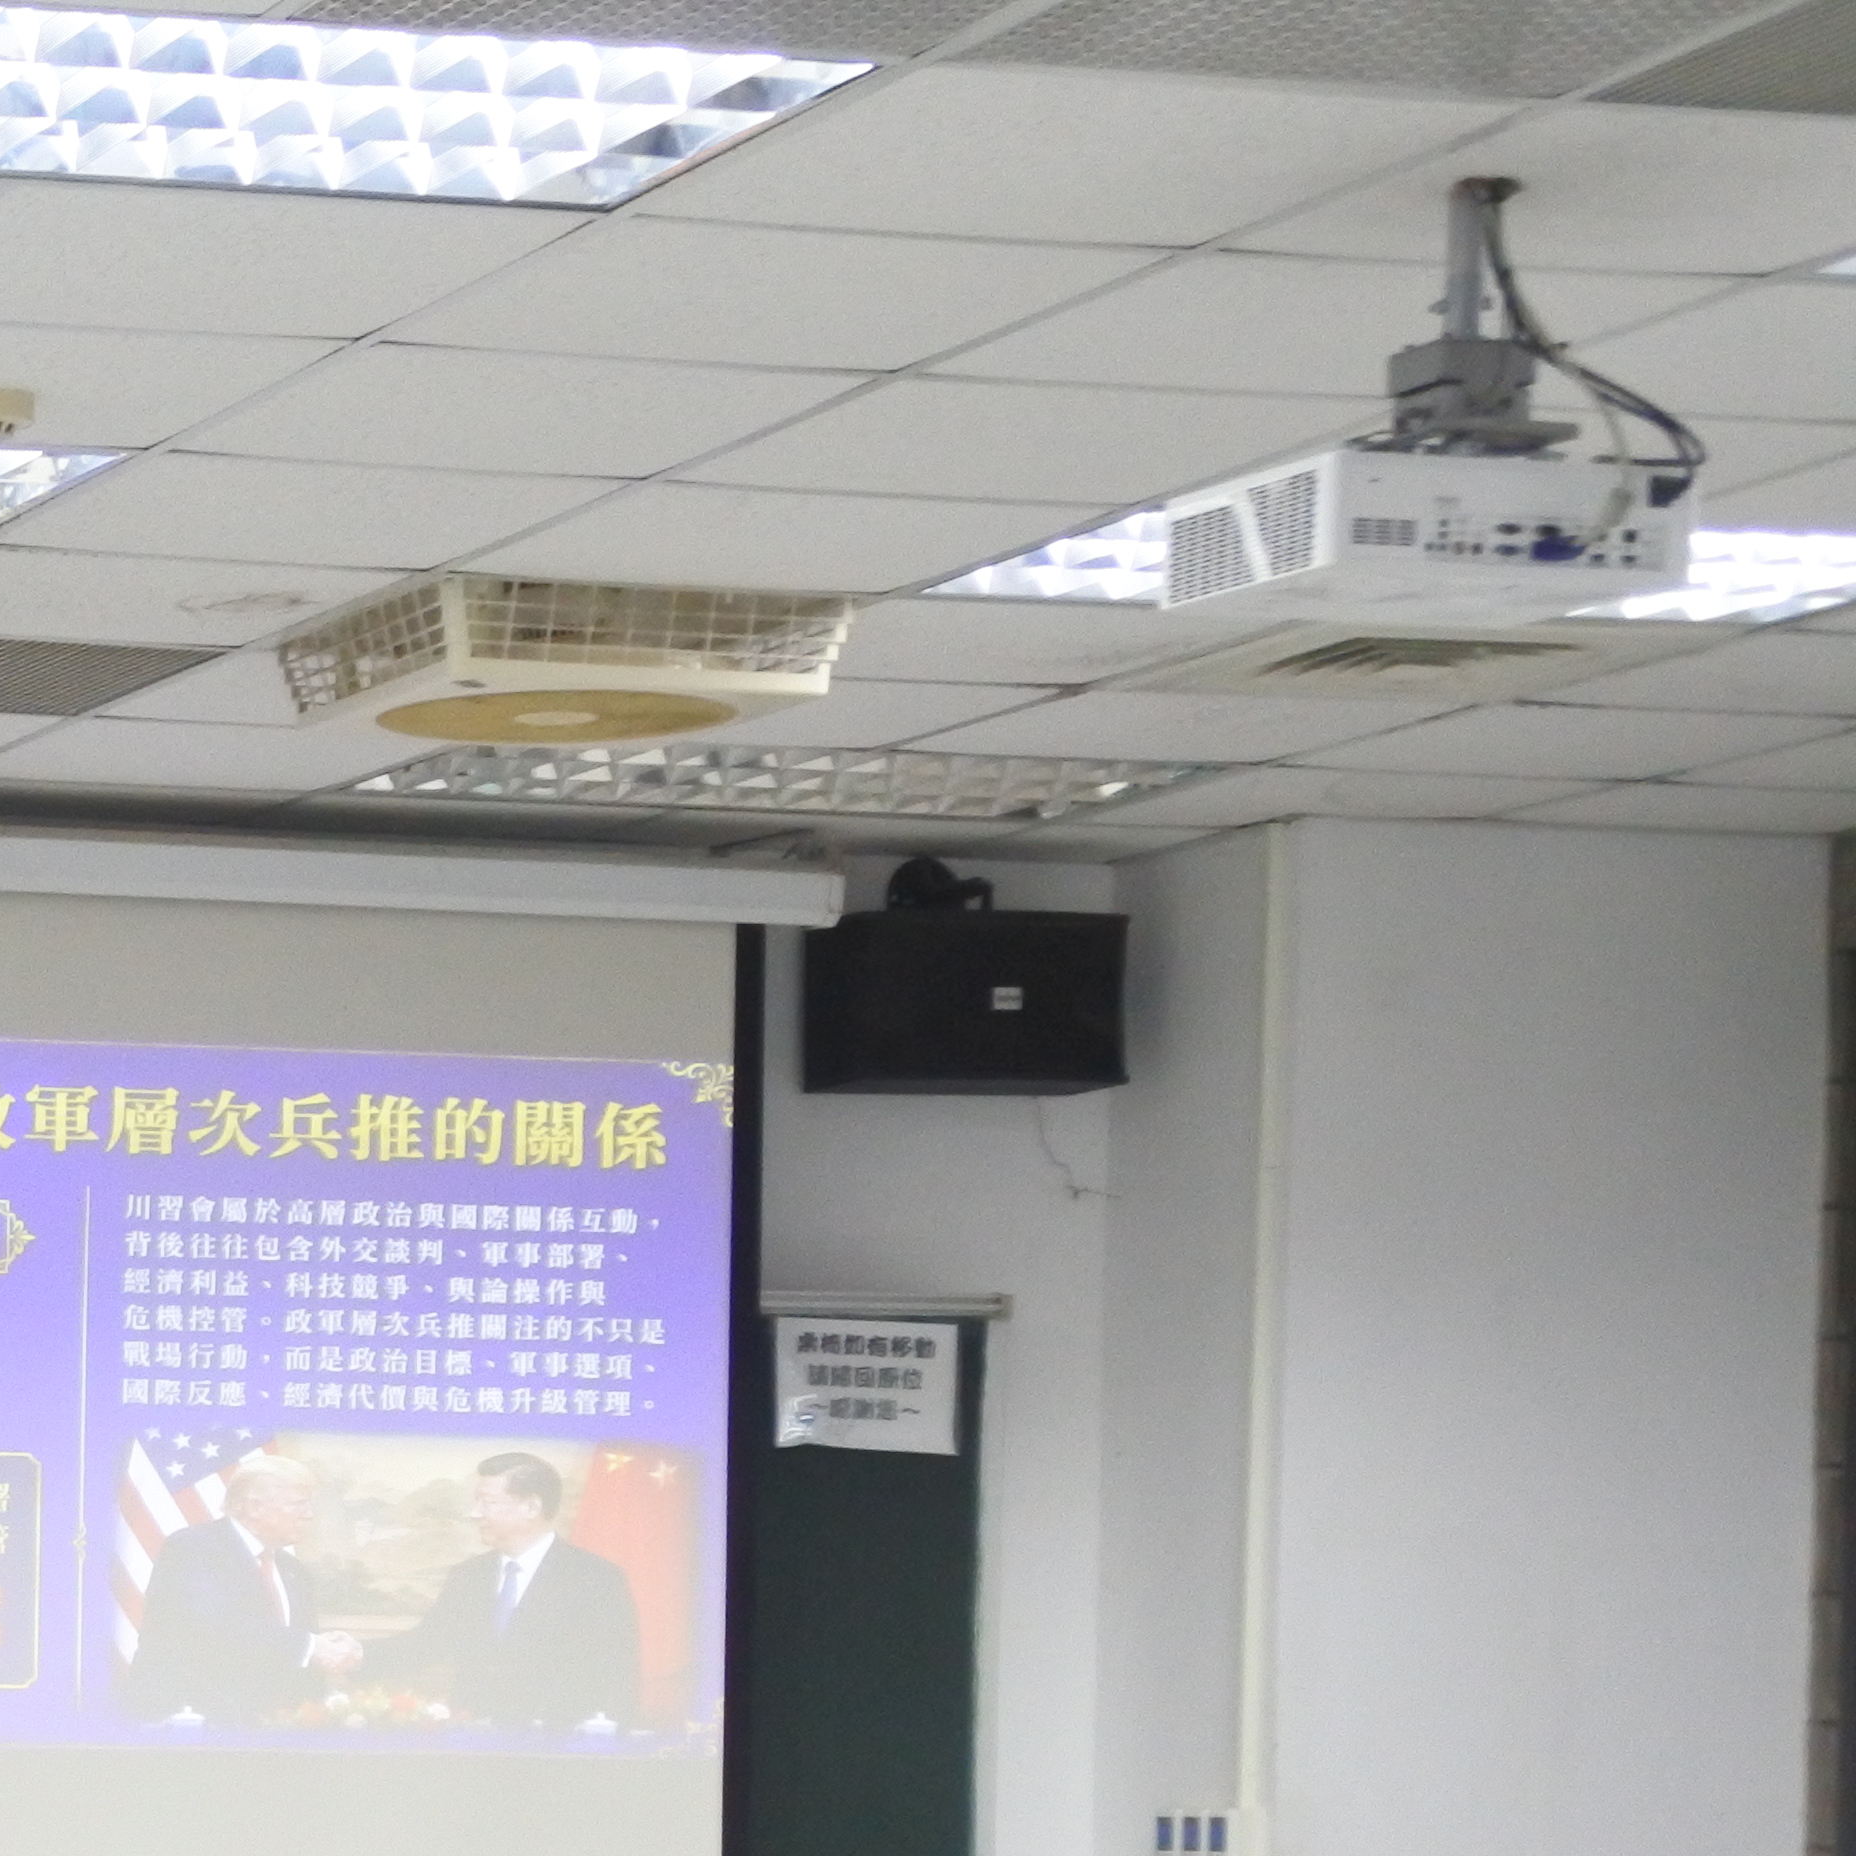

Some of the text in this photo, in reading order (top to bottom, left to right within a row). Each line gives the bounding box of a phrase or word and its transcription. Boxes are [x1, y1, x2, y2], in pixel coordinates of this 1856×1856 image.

[124, 1230, 630, 1270] 背後往往包含外交談判、軍事部署、
